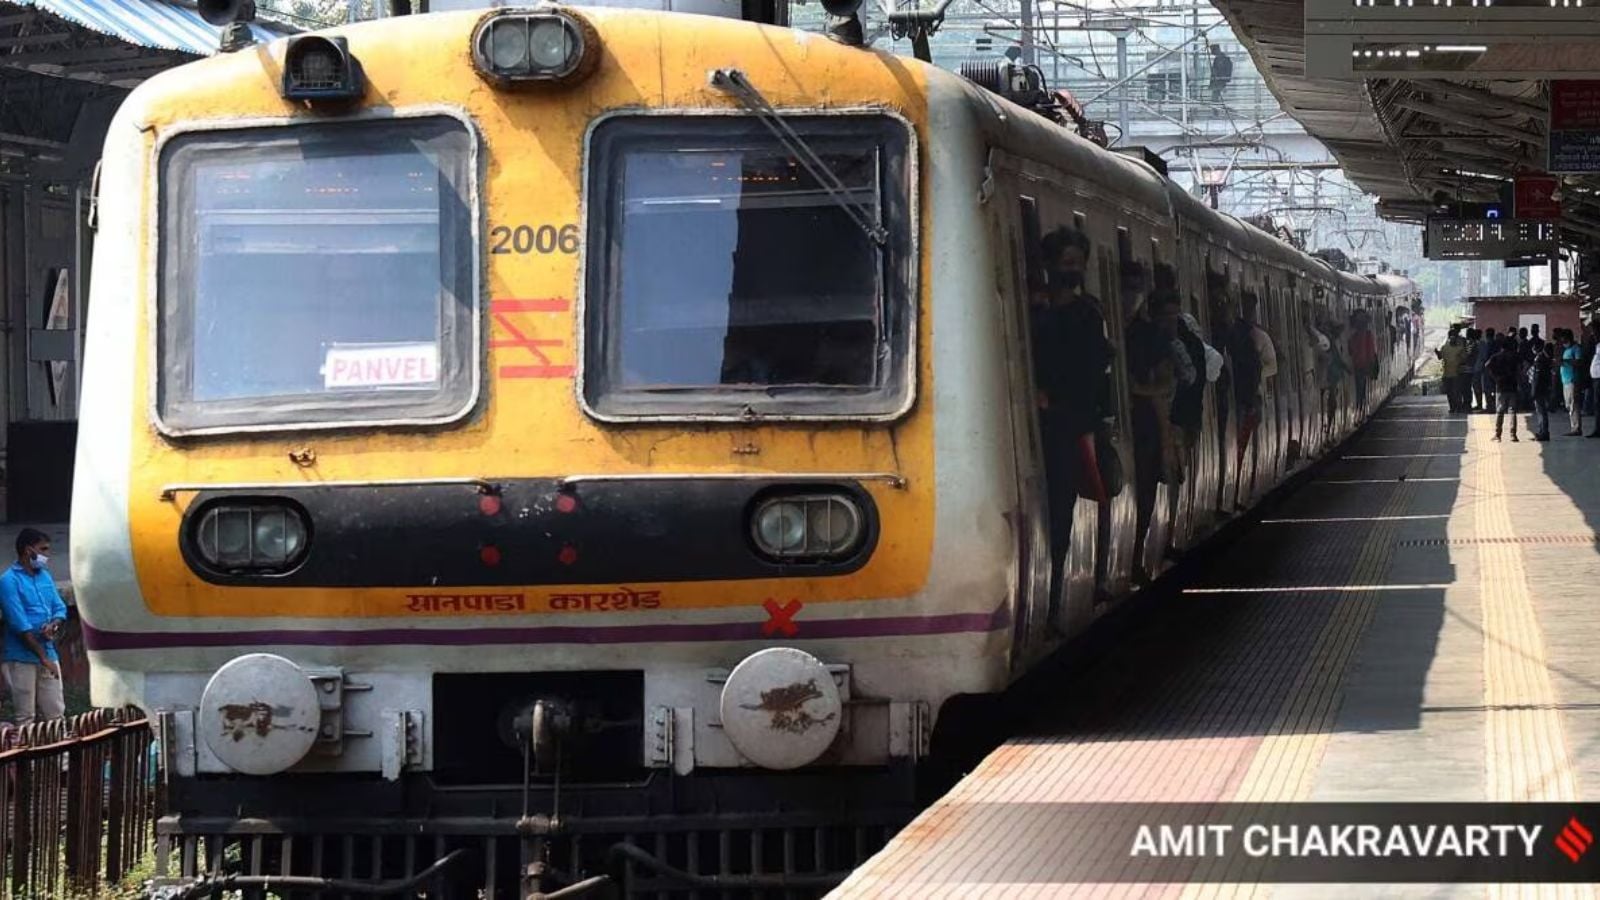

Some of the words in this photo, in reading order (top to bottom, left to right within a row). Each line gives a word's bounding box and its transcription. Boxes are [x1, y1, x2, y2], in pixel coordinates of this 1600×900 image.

[491, 224, 579, 254] 2006
[332, 357, 434, 382] PANVEL
[406, 593, 525, 612] सानपाडा
[549, 586, 662, 611] कारशेड
